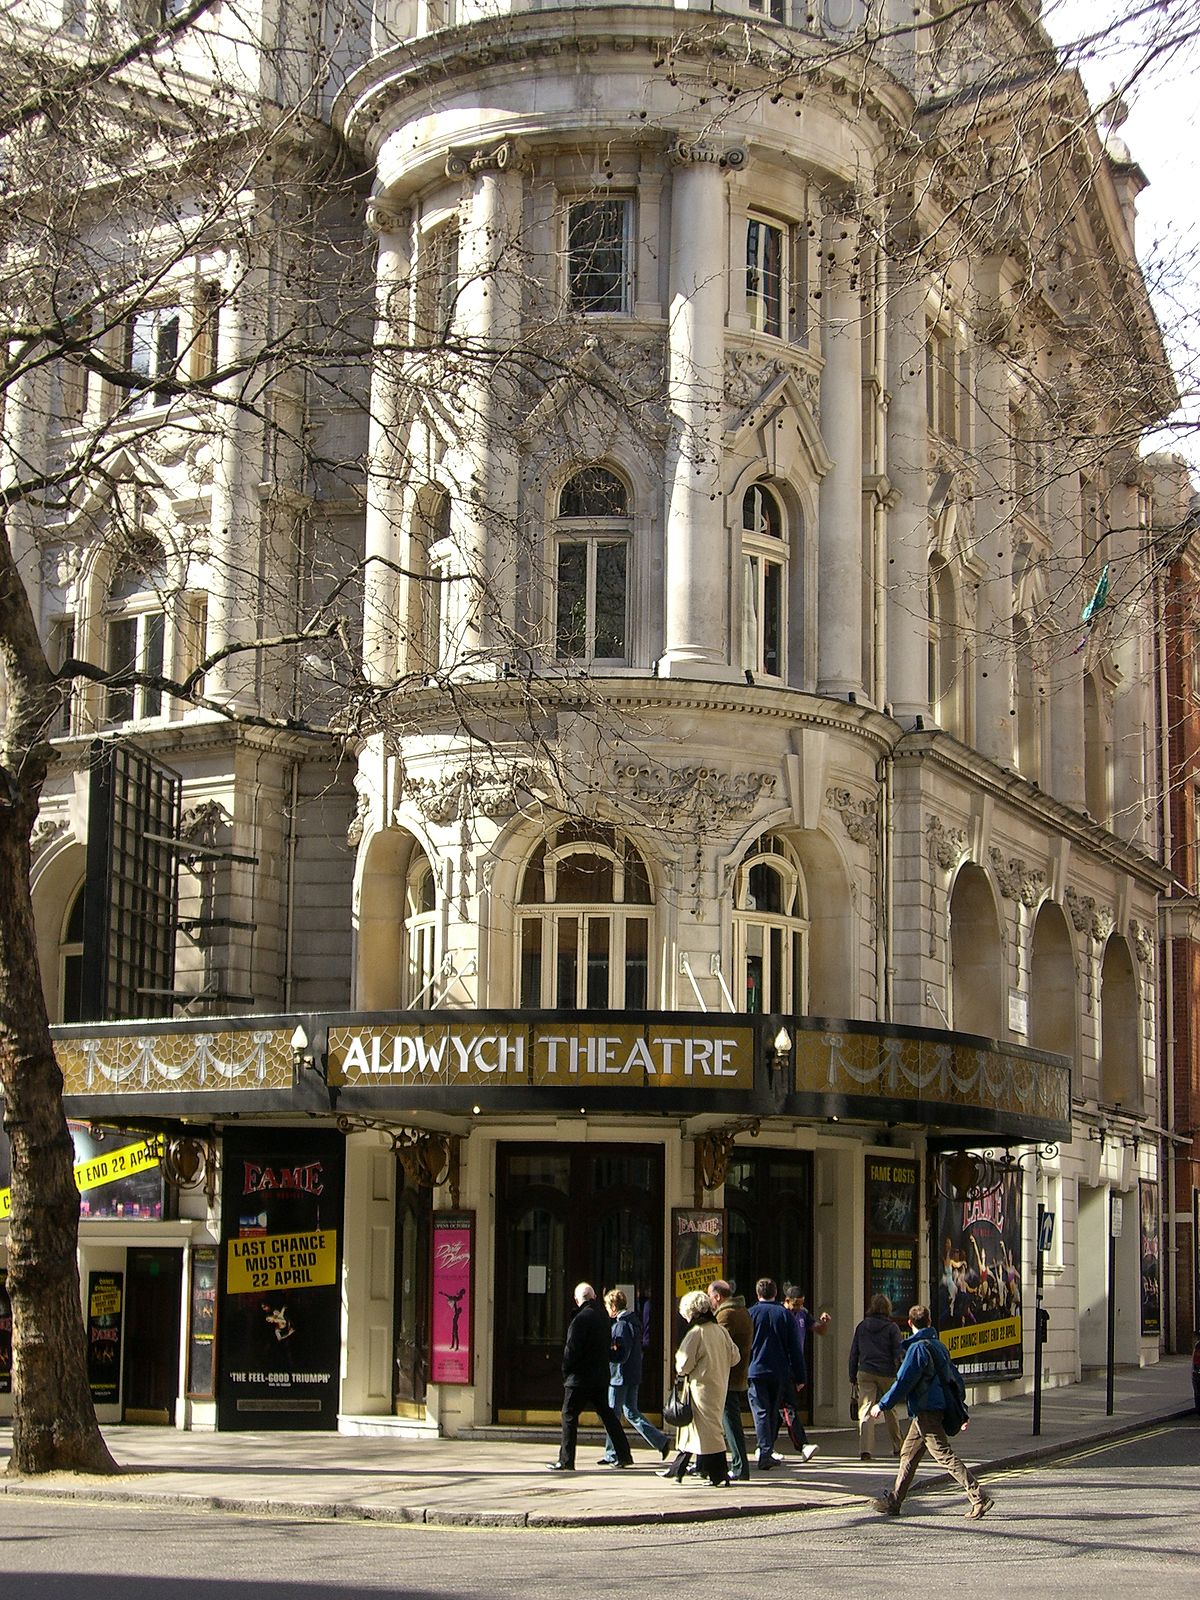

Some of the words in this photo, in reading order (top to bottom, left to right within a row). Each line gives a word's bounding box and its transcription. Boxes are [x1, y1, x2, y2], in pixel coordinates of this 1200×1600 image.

[341, 1036, 525, 1074] ALDWYCH
[537, 1037, 739, 1077] THEATRE
[87, 1162, 108, 1182] END
[111, 1156, 126, 1174] 22
[243, 1160, 324, 1195] FAME
[870, 1165, 891, 1182] FAME
[892, 1167, 915, 1185] COSTS
[678, 1216, 720, 1236] FAME
[234, 1241, 266, 1257] LAST
[271, 1235, 326, 1254] CHANCE
[245, 1255, 285, 1272] MUST
[290, 1252, 317, 1268] END
[252, 1272, 269, 1288] 22
[274, 1269, 313, 1285] APRIL
[679, 1271, 694, 1280] LAST
[694, 1265, 719, 1277] CHANCE
[684, 1277, 702, 1286] MUST
[703, 1274, 717, 1283] END
[948, 1335, 960, 1351] LAST
[978, 1329, 991, 1345] MUST
[991, 1327, 999, 1342] END
[1000, 1326, 1006, 1340] 22
[1006, 1324, 1017, 1338] APRIL
[248, 1372, 290, 1383] FEEL-GOOD
